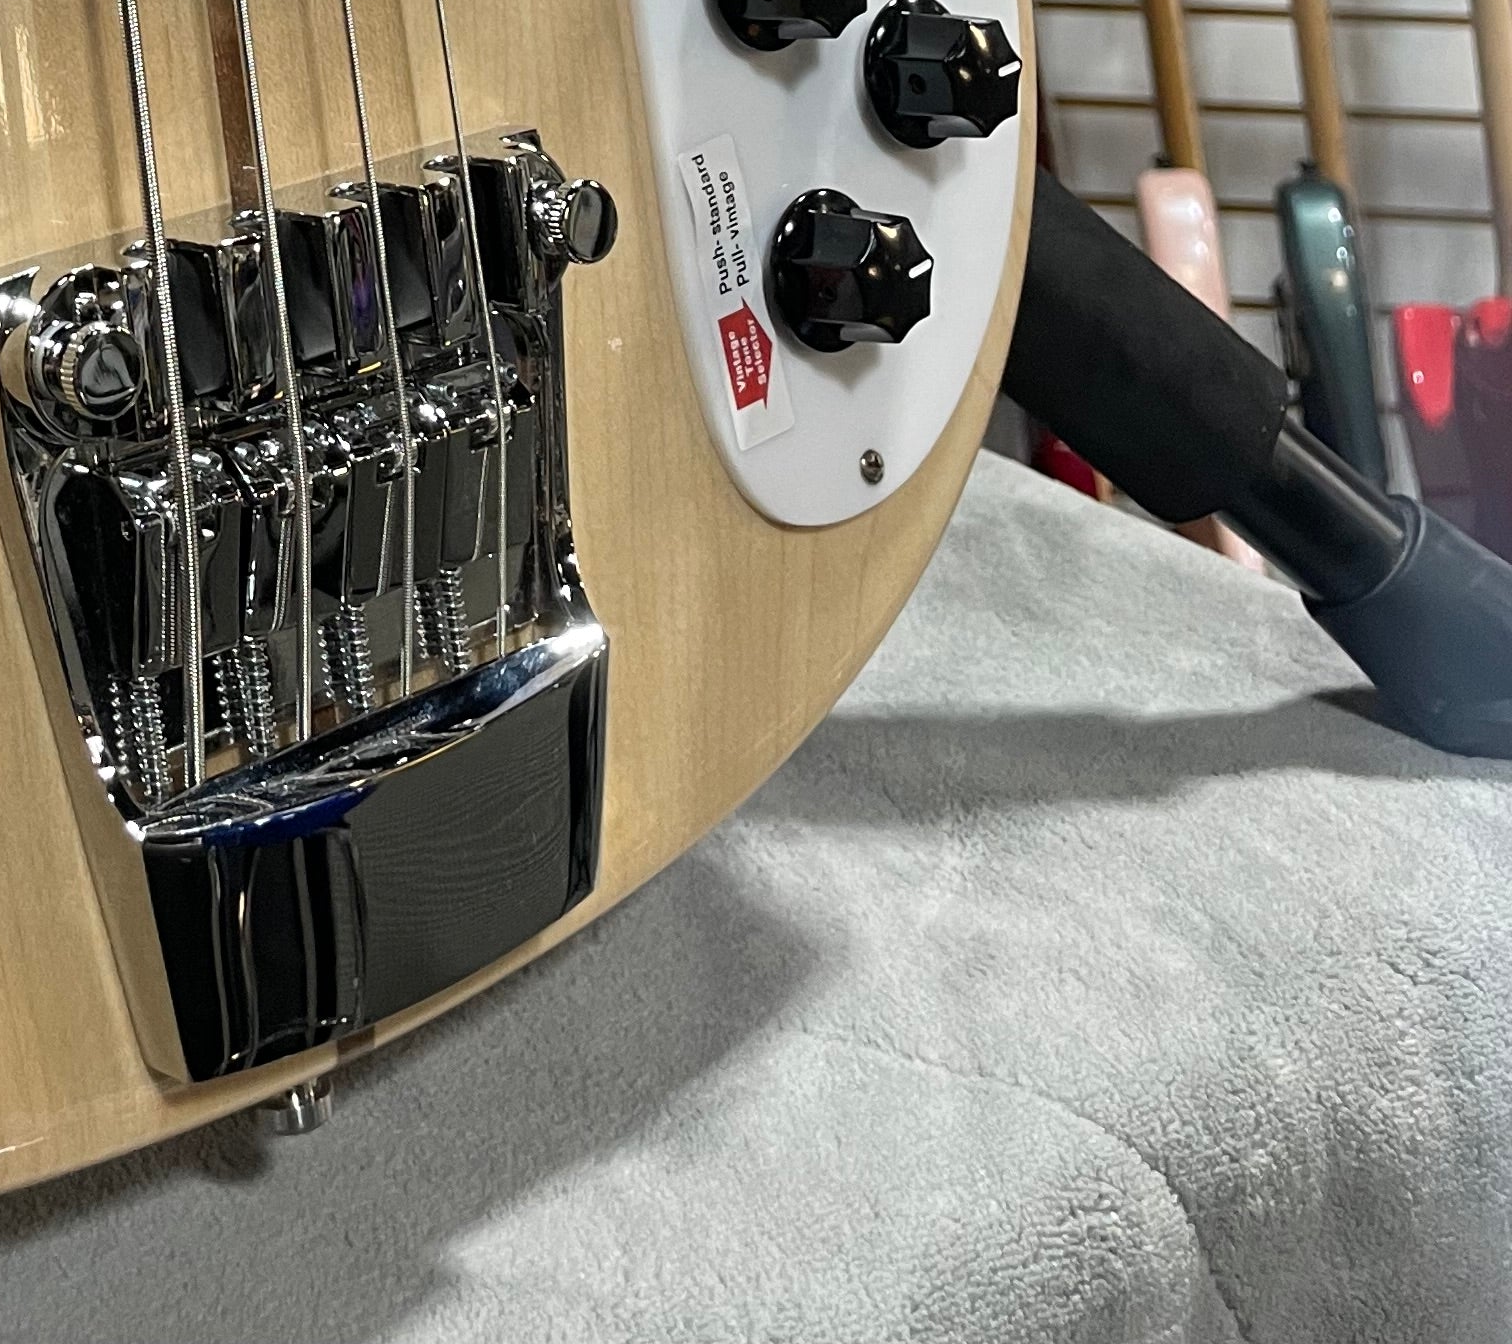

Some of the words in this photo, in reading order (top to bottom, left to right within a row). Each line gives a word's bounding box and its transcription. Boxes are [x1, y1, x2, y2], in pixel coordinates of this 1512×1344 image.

[691, 154, 722, 237] standard
[719, 171, 742, 241] vintage
[710, 239, 732, 295] Push-
[731, 243, 750, 287] Pull-
[728, 330, 746, 393] Vintage
[741, 336, 754, 377] Tone
[747, 319, 767, 385] Selector
